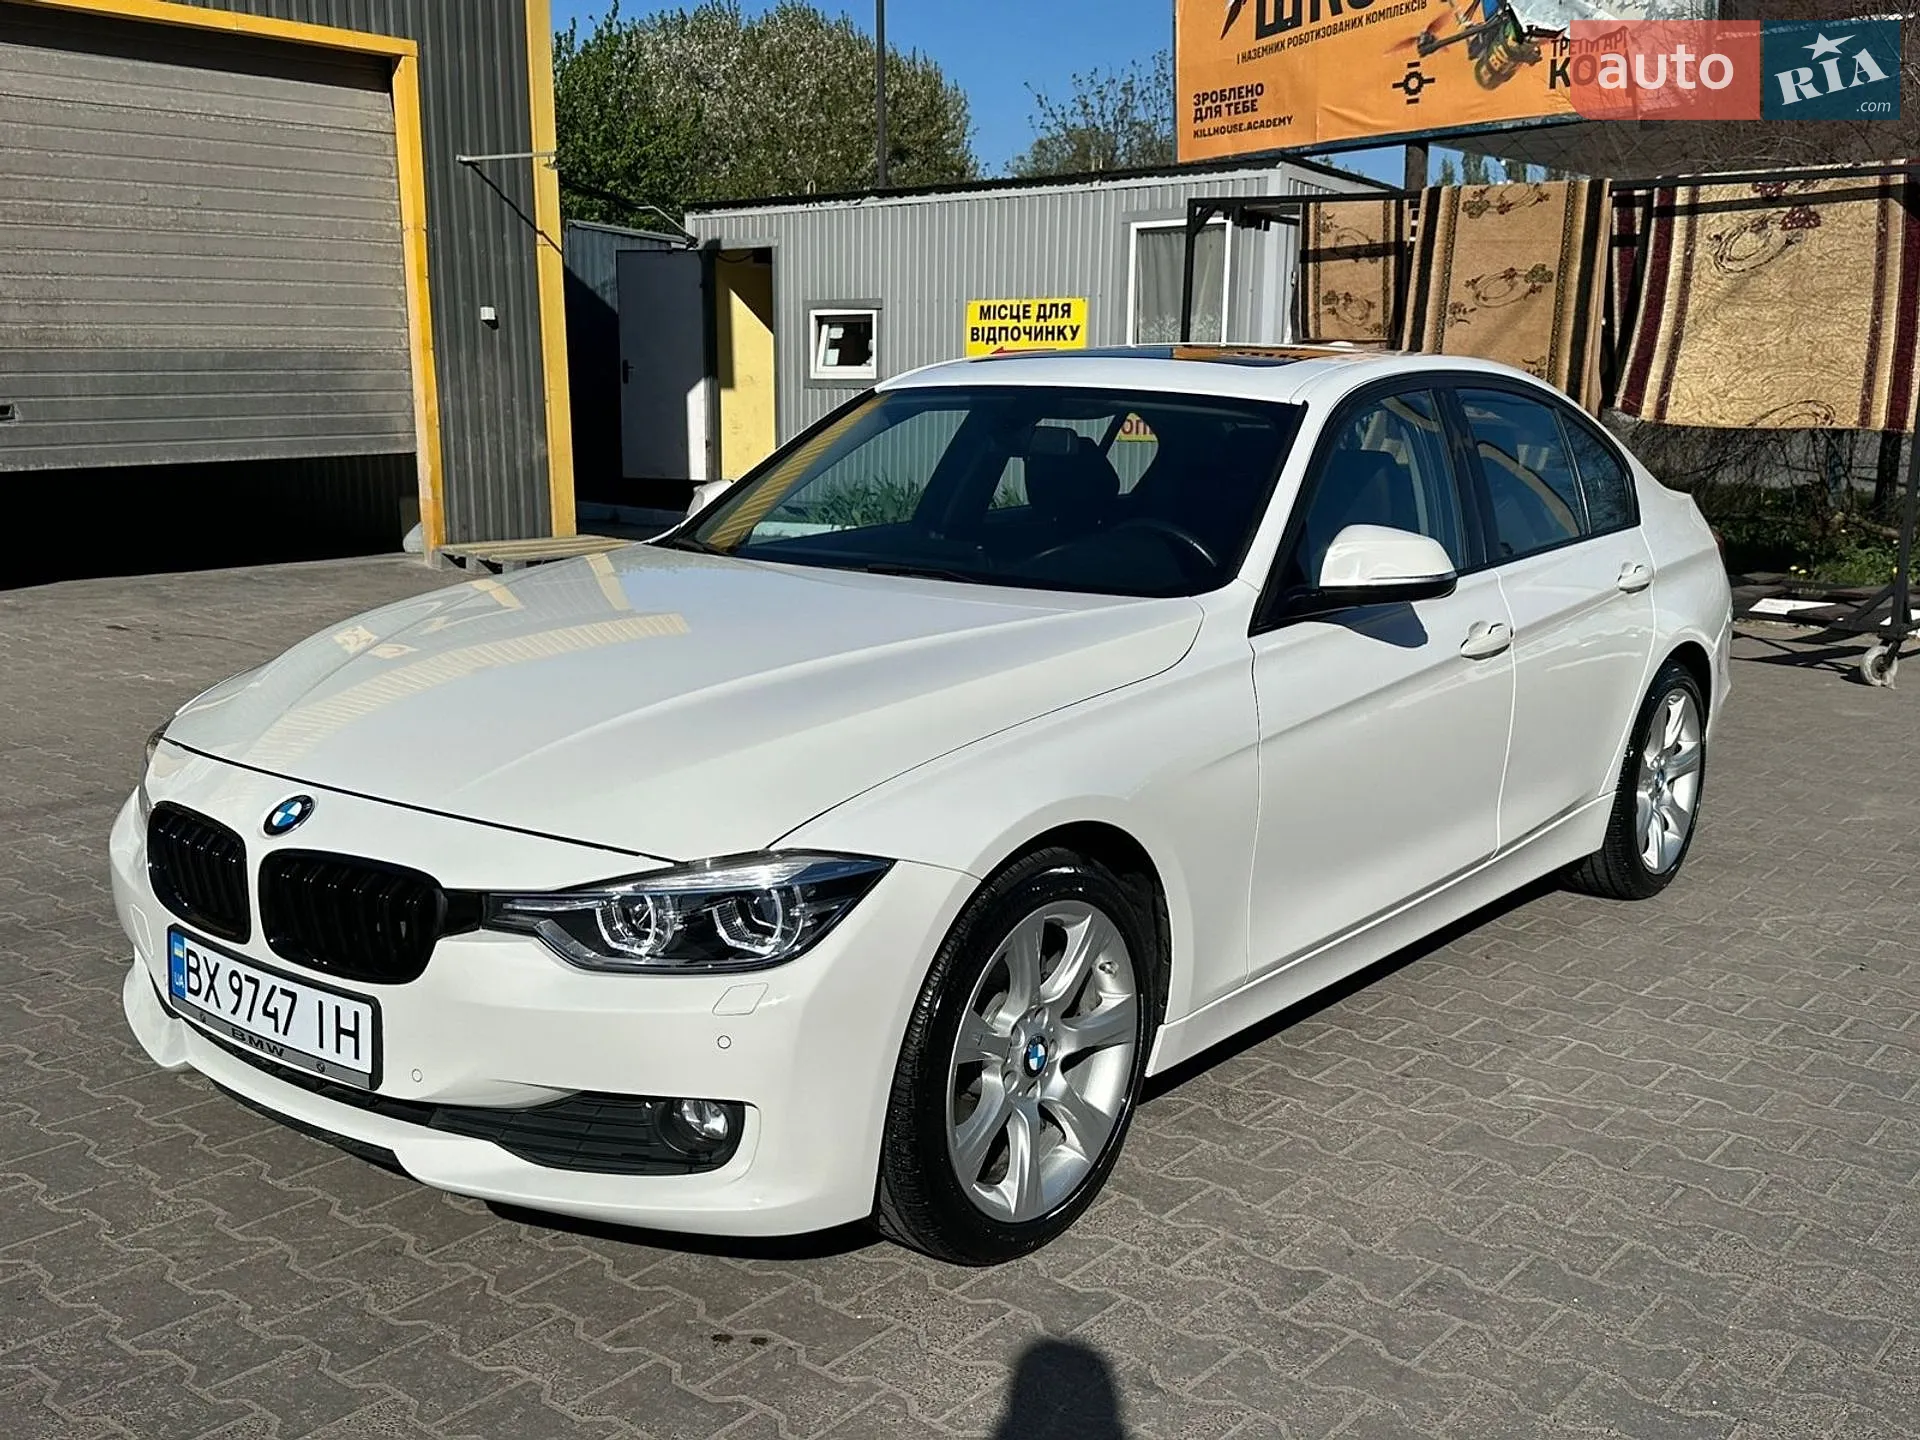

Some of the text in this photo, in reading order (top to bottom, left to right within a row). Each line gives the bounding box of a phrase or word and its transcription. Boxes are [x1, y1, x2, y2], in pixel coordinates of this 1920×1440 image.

[1241, 39, 1286, 63] НАЗЕМНИХ
[1287, 16, 1364, 49] РОБОТИЗОВАНИХ
[1365, 0, 1427, 25] КОМПЛЕКСІВ
[1193, 82, 1265, 106] ЗРОБЛЕНО
[1193, 99, 1258, 124] ДЛЯ ТЕБЕ
[1193, 115, 1294, 139] KILLHOUSE.ACADEMY
[979, 302, 1072, 323] МІСЦЕ ДЛЯ
[970, 324, 1081, 345] ВІДПОЧИНКУ
[186, 948, 361, 1061] BX 9747 IH
[230, 1027, 285, 1057] BMW
